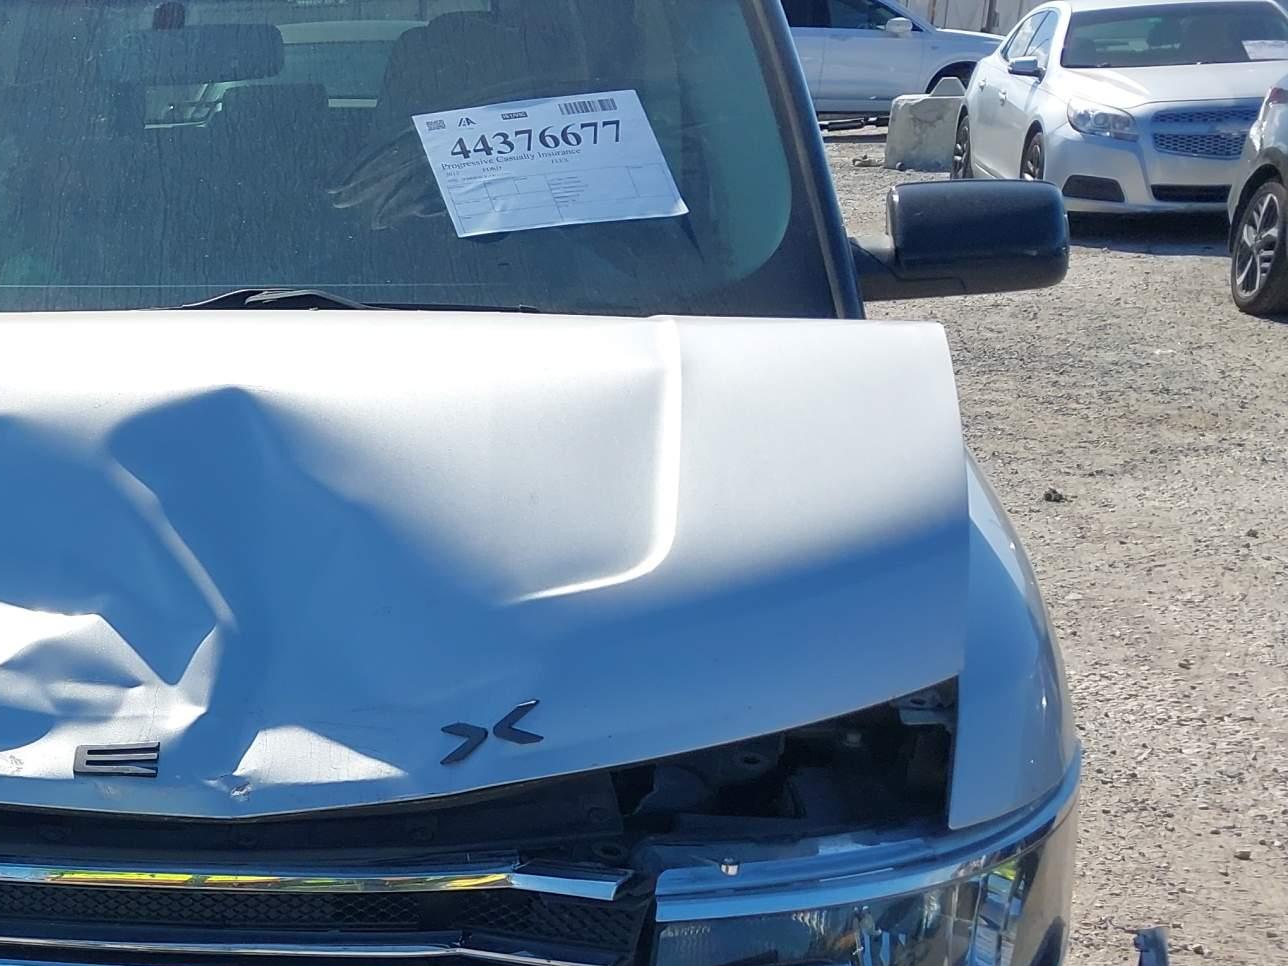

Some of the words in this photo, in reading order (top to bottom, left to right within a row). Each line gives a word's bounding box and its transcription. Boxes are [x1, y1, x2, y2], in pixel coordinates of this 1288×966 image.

[450, 119, 621, 159] 44376677
[441, 158, 494, 170] Progressive
[538, 147, 581, 158] Insurance
